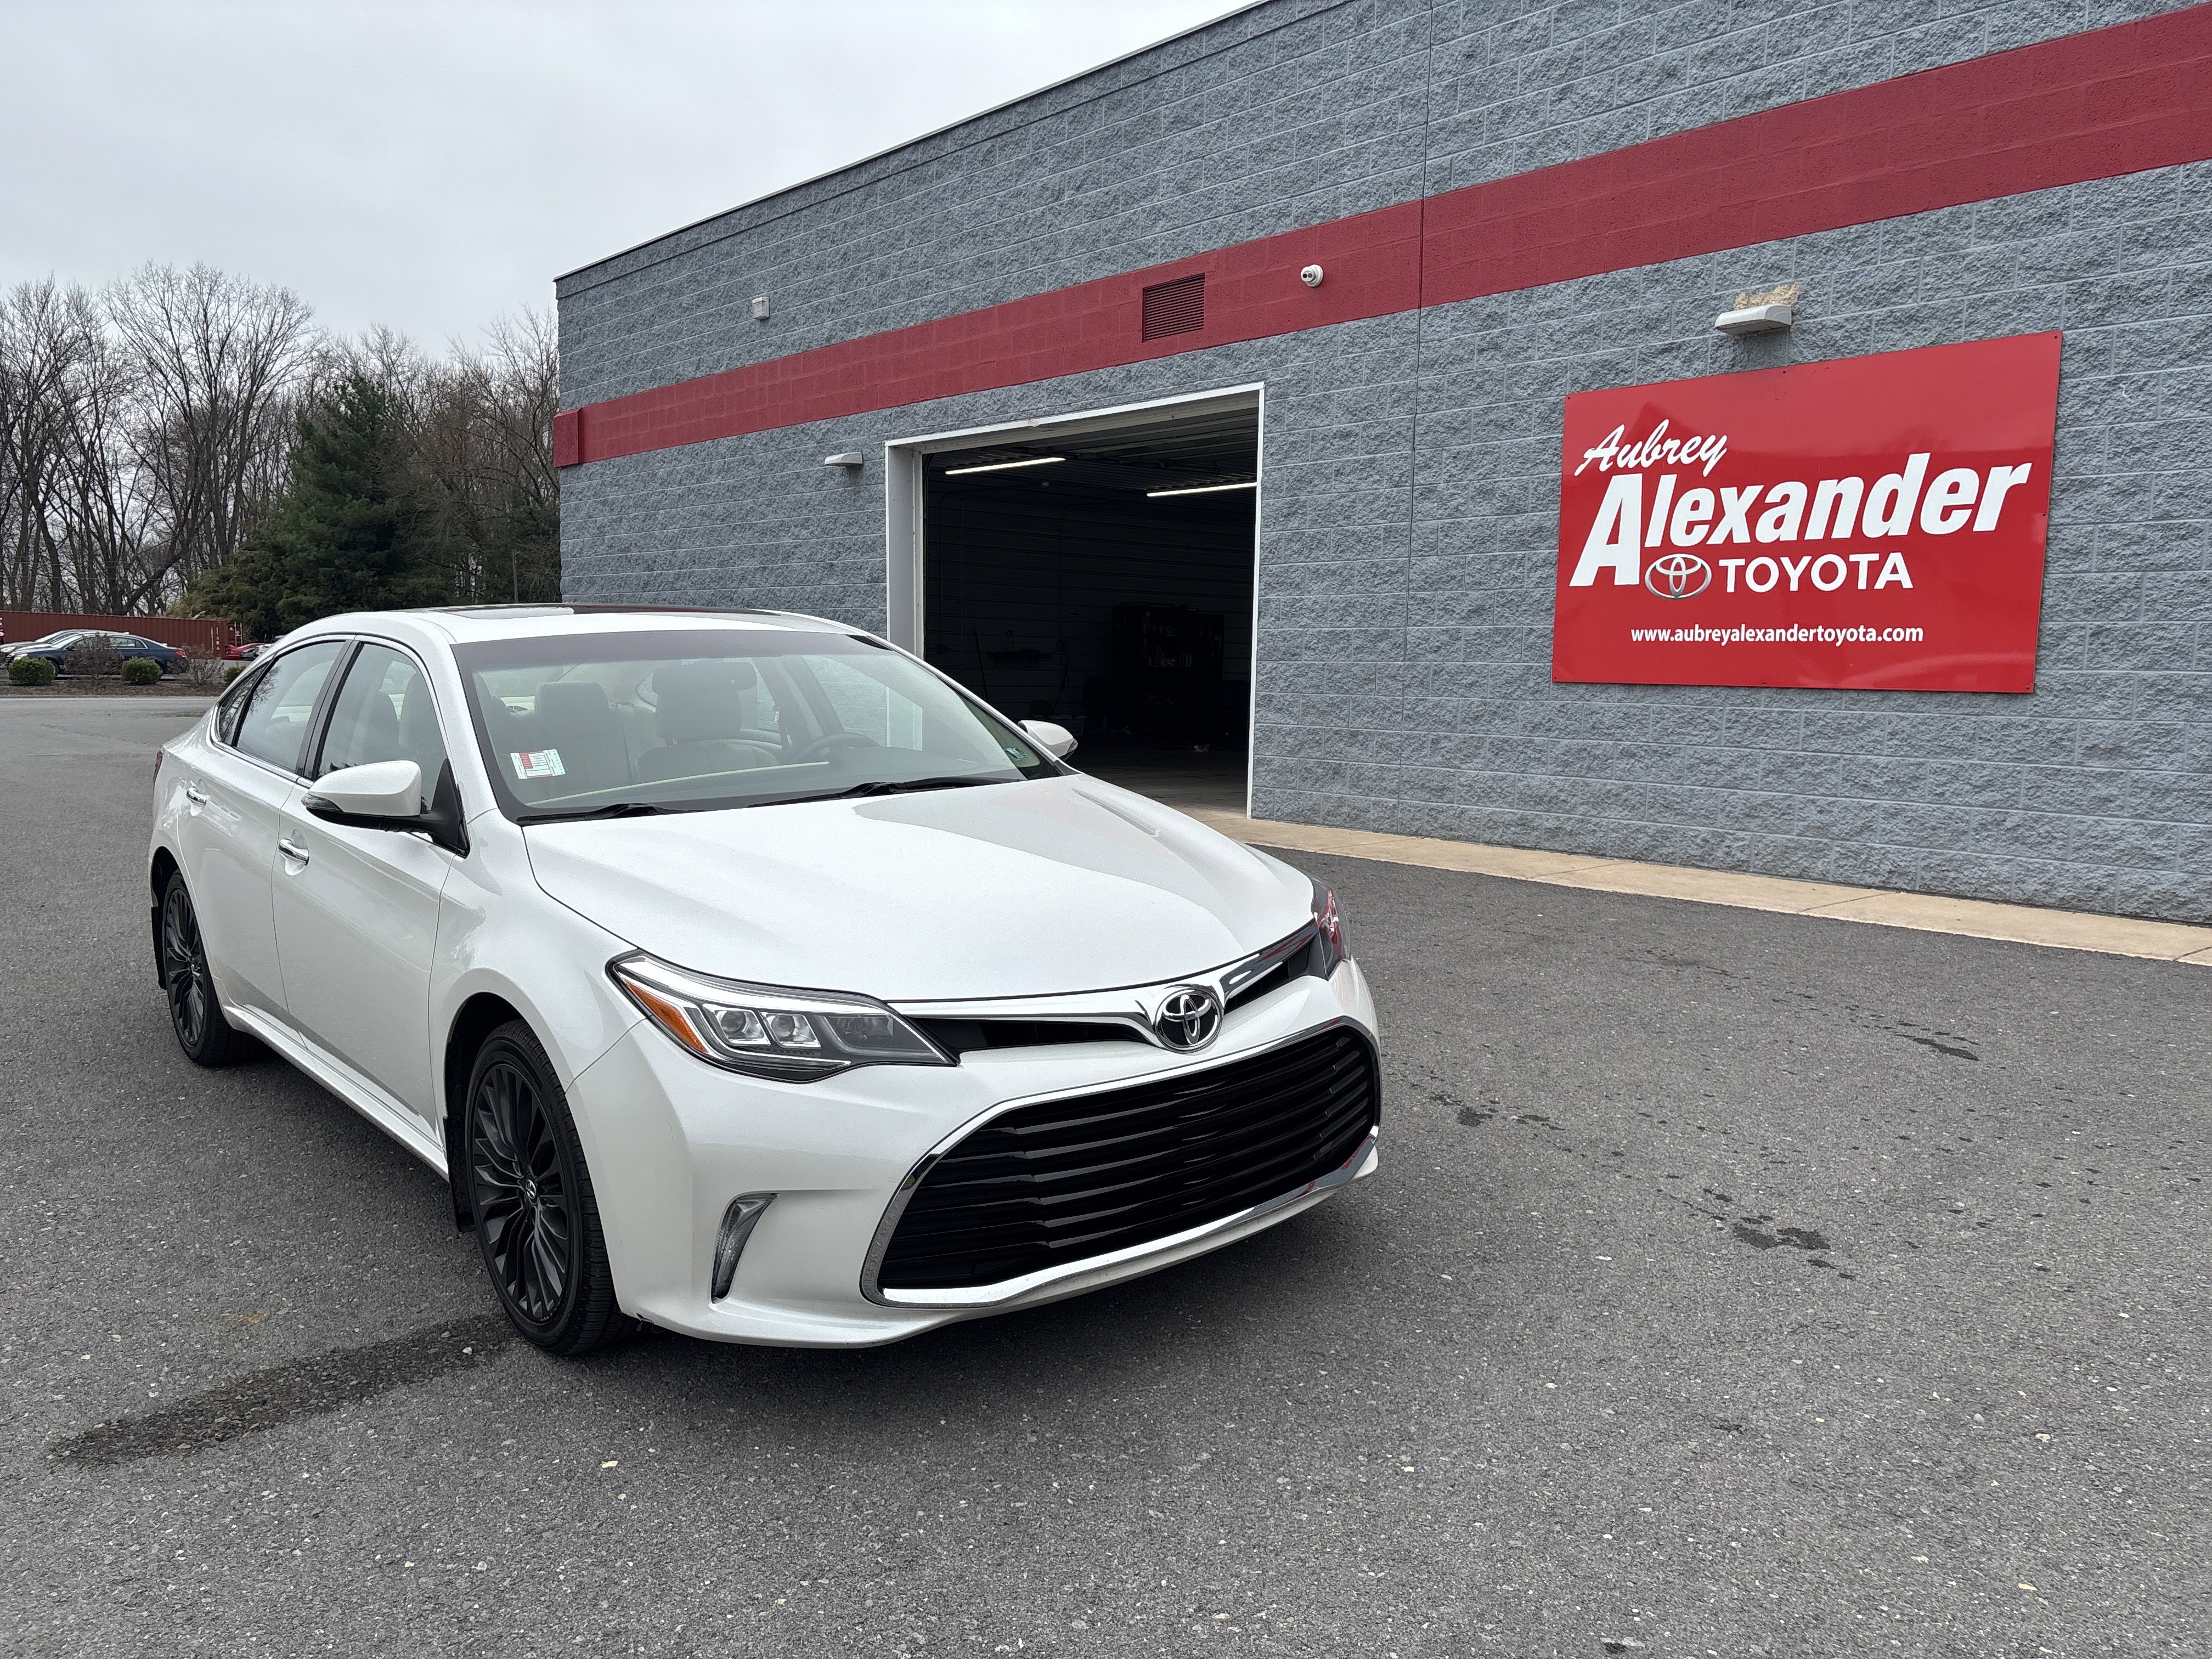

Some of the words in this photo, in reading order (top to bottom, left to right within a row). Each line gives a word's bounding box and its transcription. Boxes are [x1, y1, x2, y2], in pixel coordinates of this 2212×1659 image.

[1575, 419, 1728, 477] Aubrey
[1569, 452, 2032, 587] Alexander
[1718, 552, 1914, 593] TOYOTA
[1630, 623, 1923, 647] www.aubreyalexandertoyota.com
